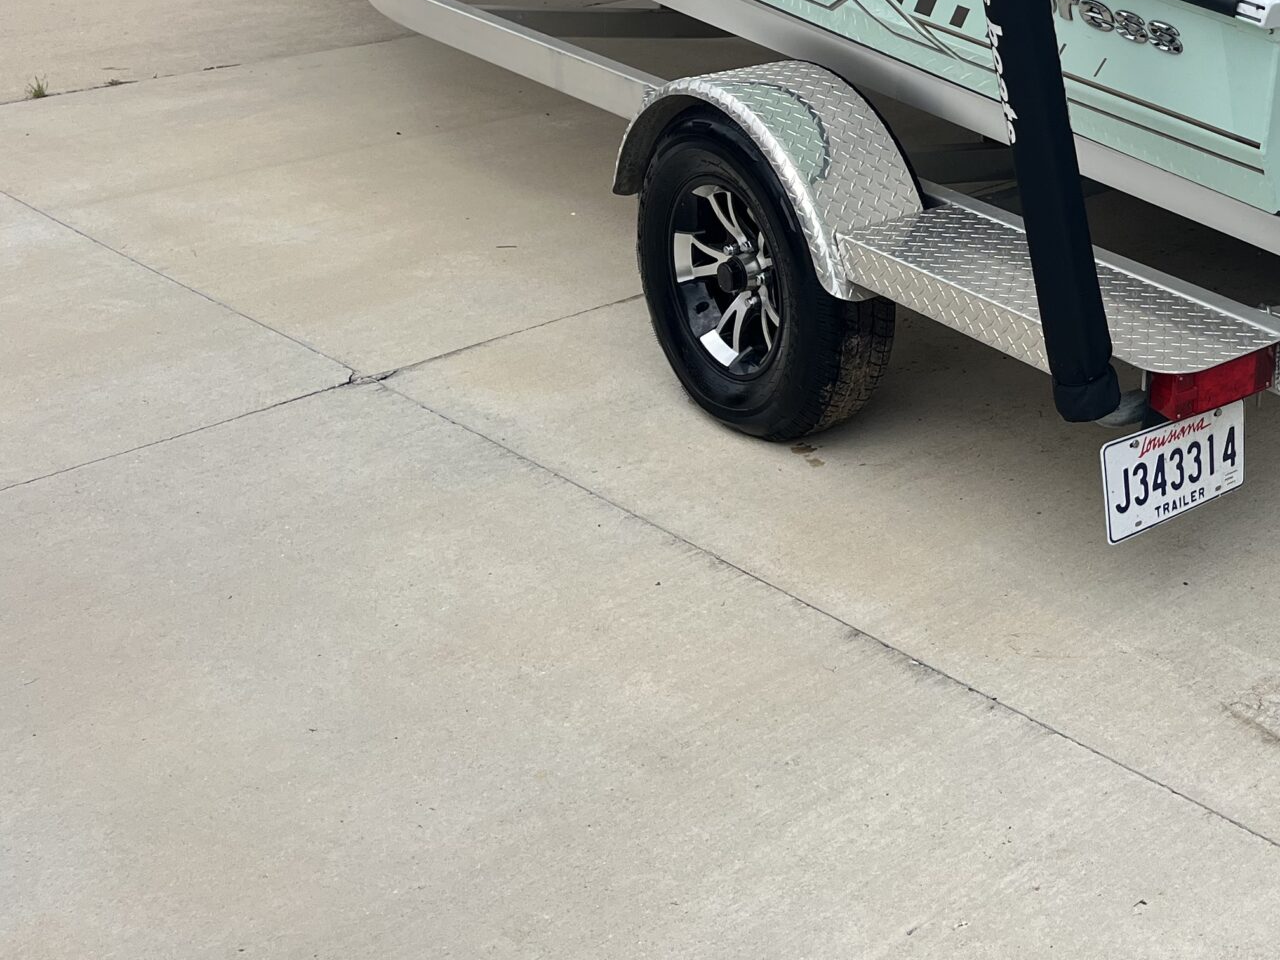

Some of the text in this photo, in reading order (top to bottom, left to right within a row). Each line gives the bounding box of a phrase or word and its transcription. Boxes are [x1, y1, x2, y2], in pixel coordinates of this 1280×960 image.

[1138, 417, 1212, 458] Louisiana
[1115, 426, 1237, 514] J343314
[1155, 487, 1205, 518] TRAILER
